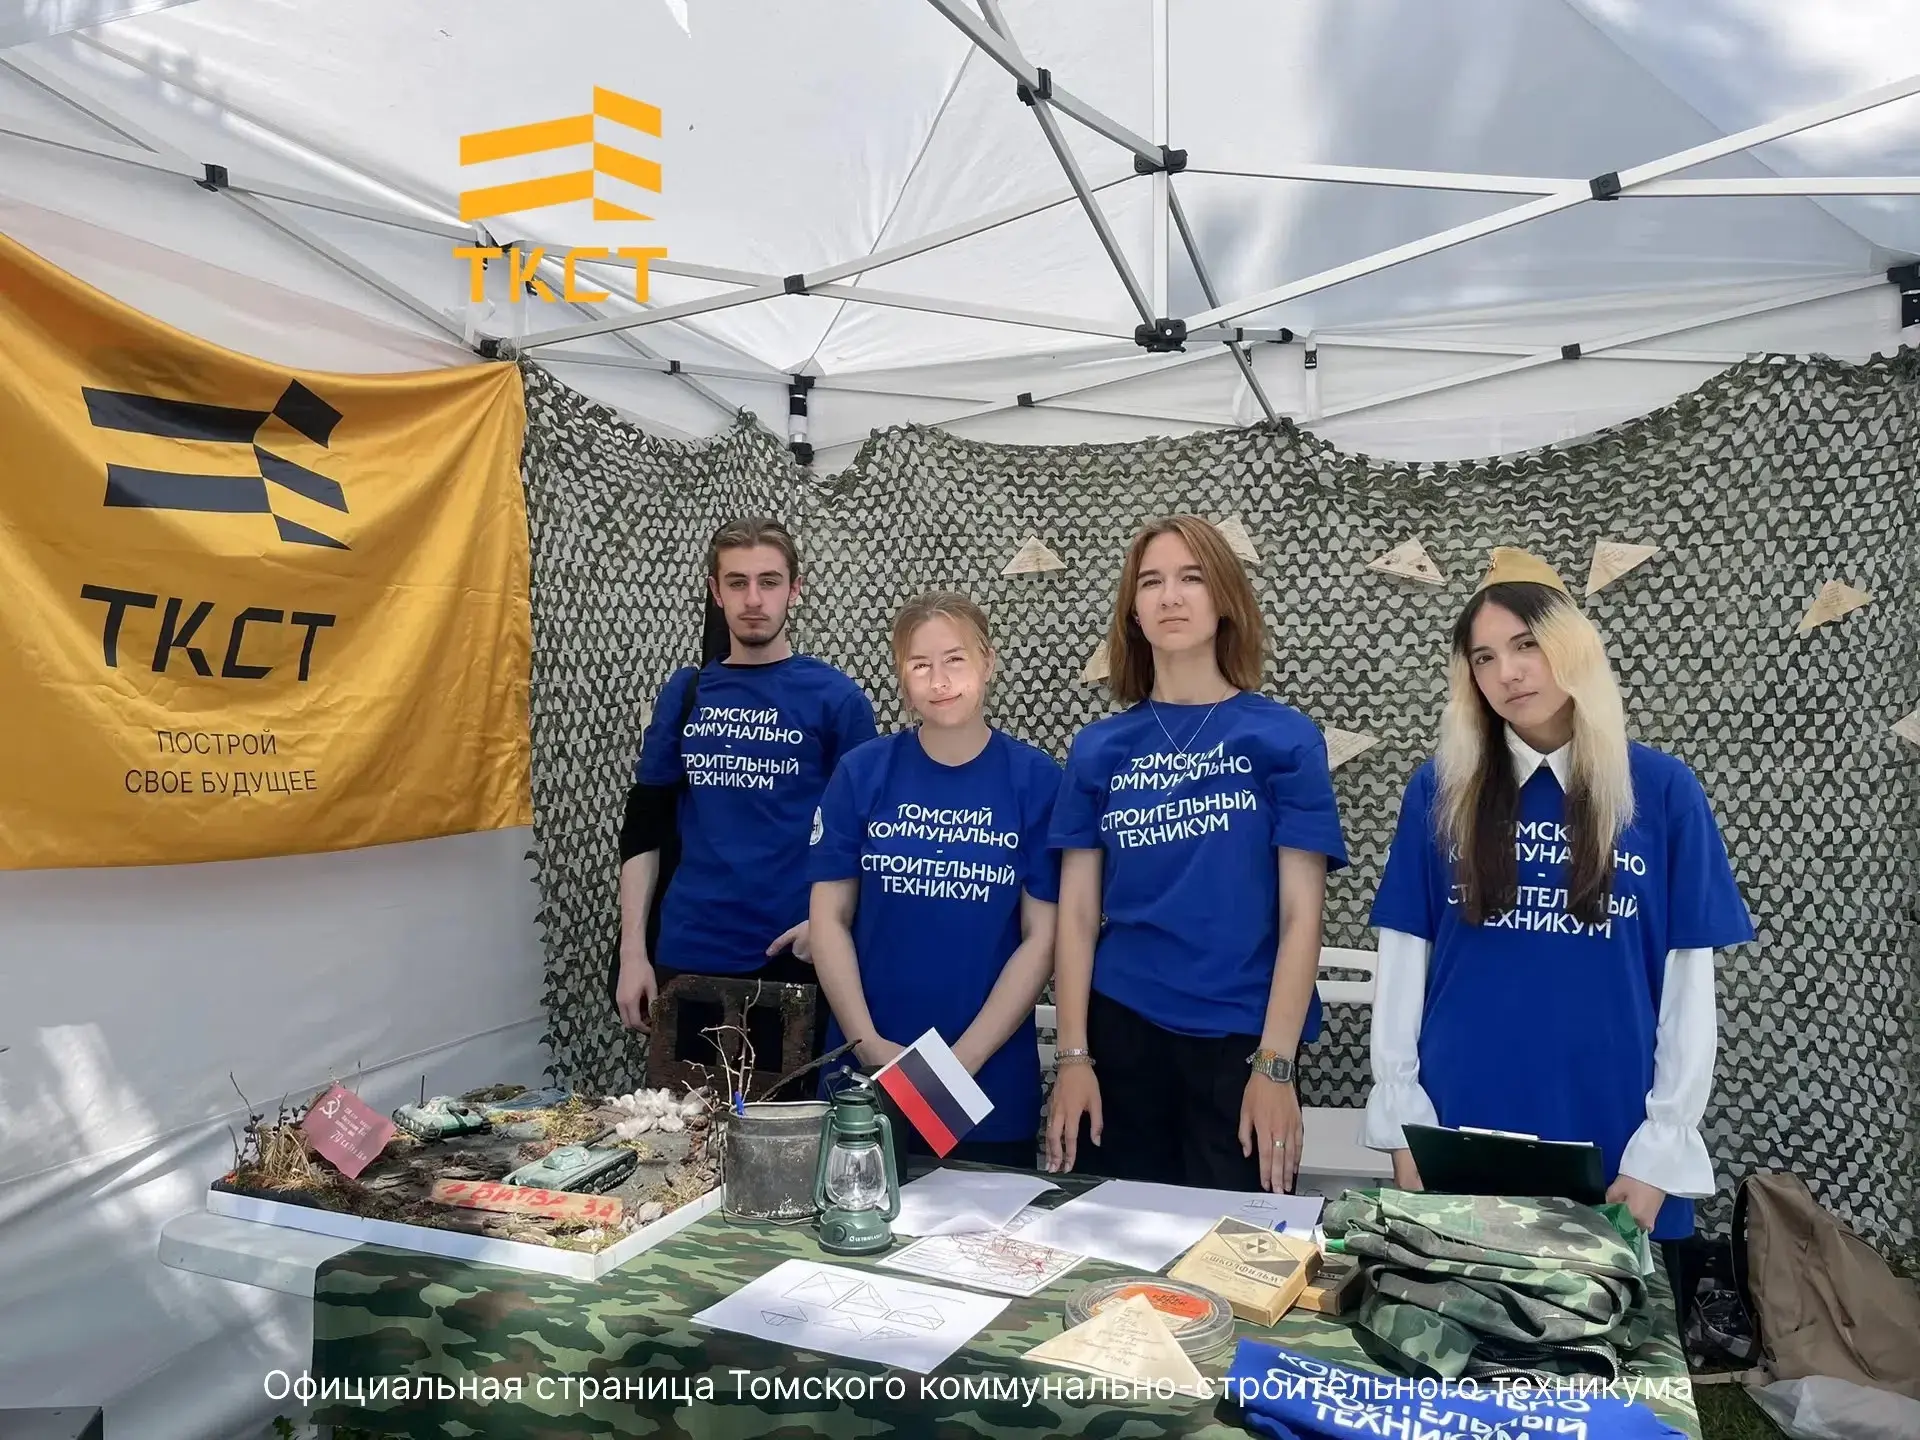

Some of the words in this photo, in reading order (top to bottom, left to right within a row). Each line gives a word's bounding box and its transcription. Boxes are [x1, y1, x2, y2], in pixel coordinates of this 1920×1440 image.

[80, 584, 336, 681] ТКСТ
[158, 729, 277, 756] ПОСТРОЙ
[683, 723, 803, 744] ОММУНАЛЬНО
[125, 769, 193, 795] СВОЕ
[201, 770, 318, 798] БУДУЩЕЕ
[687, 770, 774, 790] ТЕХНИКУМ
[897, 803, 993, 826] ТОМСКИЙ
[1101, 789, 1257, 832] СТРОИТЕЛЬНЫЙ
[868, 821, 1019, 849] КОММУНАЛЬНО
[1117, 812, 1230, 849] ТЕХНИКУМ
[861, 854, 1016, 886] СТРОИТЕЛЬНЫЙ
[881, 875, 990, 902] ТЕХНИКУМ
[1484, 907, 1612, 939] ЕХНИКУМ
